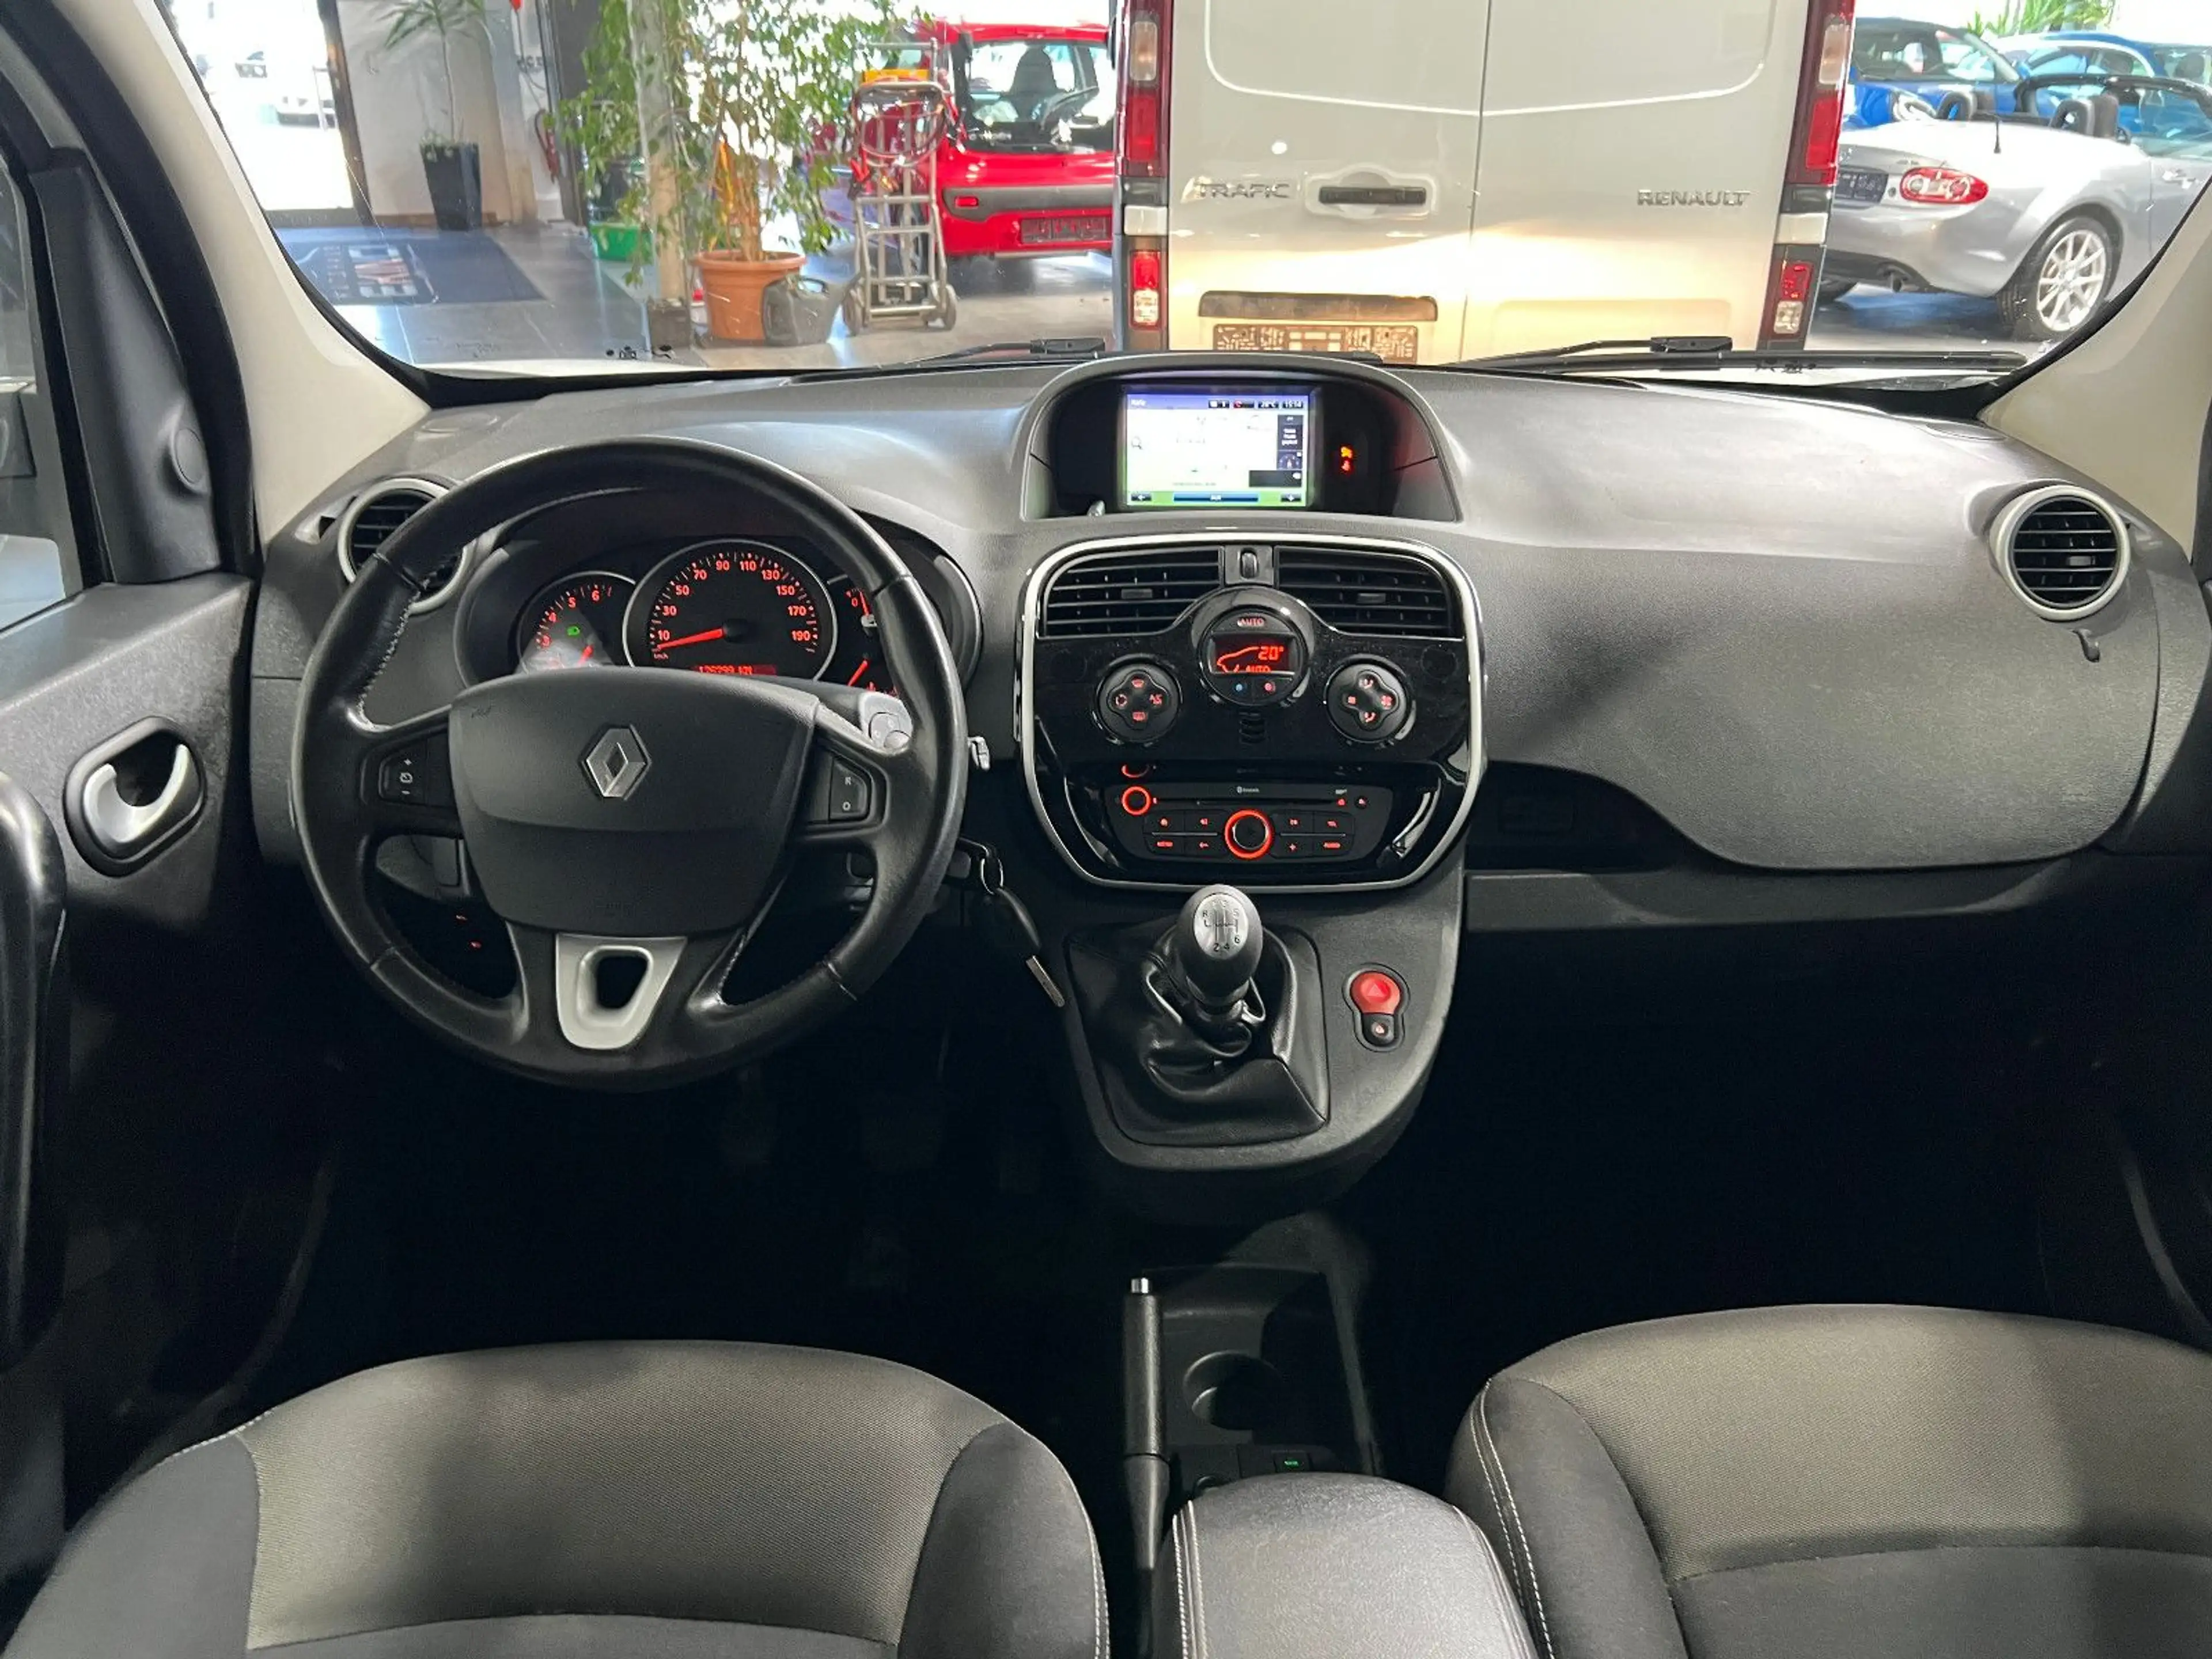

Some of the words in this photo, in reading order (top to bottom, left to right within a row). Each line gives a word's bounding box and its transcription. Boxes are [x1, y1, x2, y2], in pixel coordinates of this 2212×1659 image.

[1195, 182, 1290, 198] TRAFIC
[1637, 190, 1751, 206] RENAULT
[716, 560, 730, 570] 90
[740, 560, 756, 571] 110
[694, 569, 707, 580] 70
[762, 569, 780, 581] 130
[592, 590, 600, 601] 6
[676, 585, 690, 596] 50
[778, 585, 795, 596] 150
[568, 597, 576, 608] 5
[662, 605, 677, 616] 30
[787, 605, 806, 616] 170
[548, 612, 556, 623] 4
[1237, 618, 1265, 627] AUTO
[541, 635, 550, 647] 3
[657, 630, 671, 641] 10
[791, 630, 810, 641] 190
[1234, 934, 1241, 944] 6
[1213, 942, 1219, 952] 2
